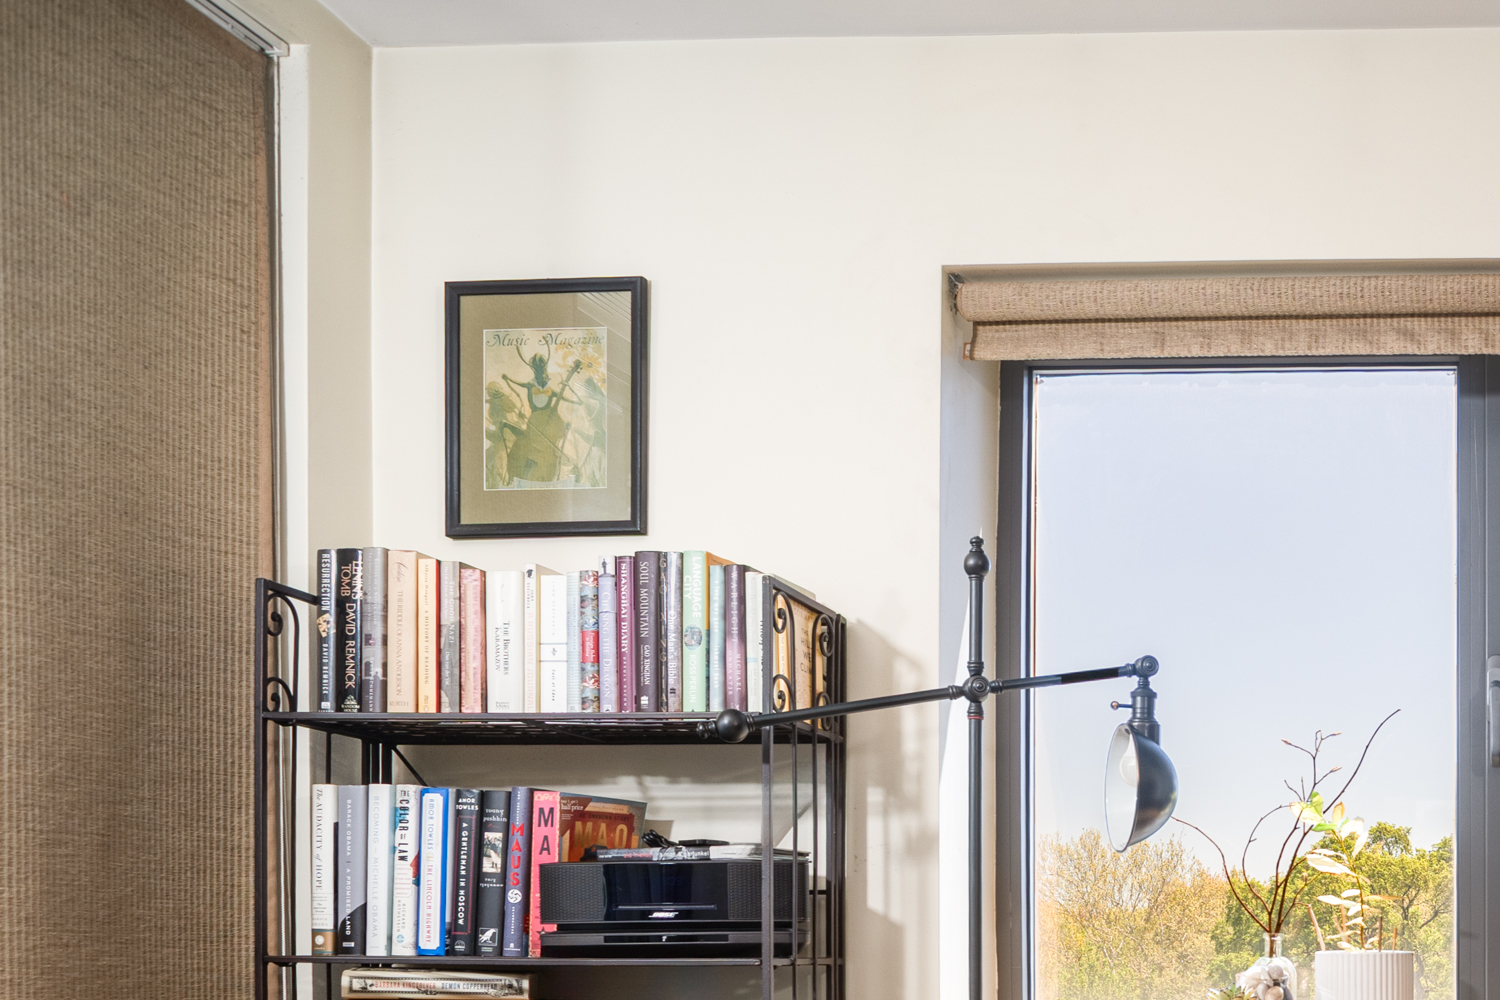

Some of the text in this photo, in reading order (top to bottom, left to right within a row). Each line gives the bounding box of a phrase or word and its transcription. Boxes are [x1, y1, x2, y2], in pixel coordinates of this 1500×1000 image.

[486, 332, 604, 348] Music Magazine
[321, 553, 330, 611] RESURRECTION
[341, 566, 351, 596] TOMB
[620, 563, 628, 618] SHANGHAI
[640, 561, 649, 637] SOUL MOUNTAIN
[684, 575, 693, 599] CITY
[692, 556, 701, 618] LANGUAGE
[668, 611, 676, 630] One
[345, 603, 356, 688] DAVID REMNICK
[668, 633, 676, 659] Man's
[397, 799, 409, 862] COLOR LAW
[460, 831, 468, 875] GENTLEMAN
[510, 823, 524, 886] MAUS
[459, 878, 465, 886] IN
